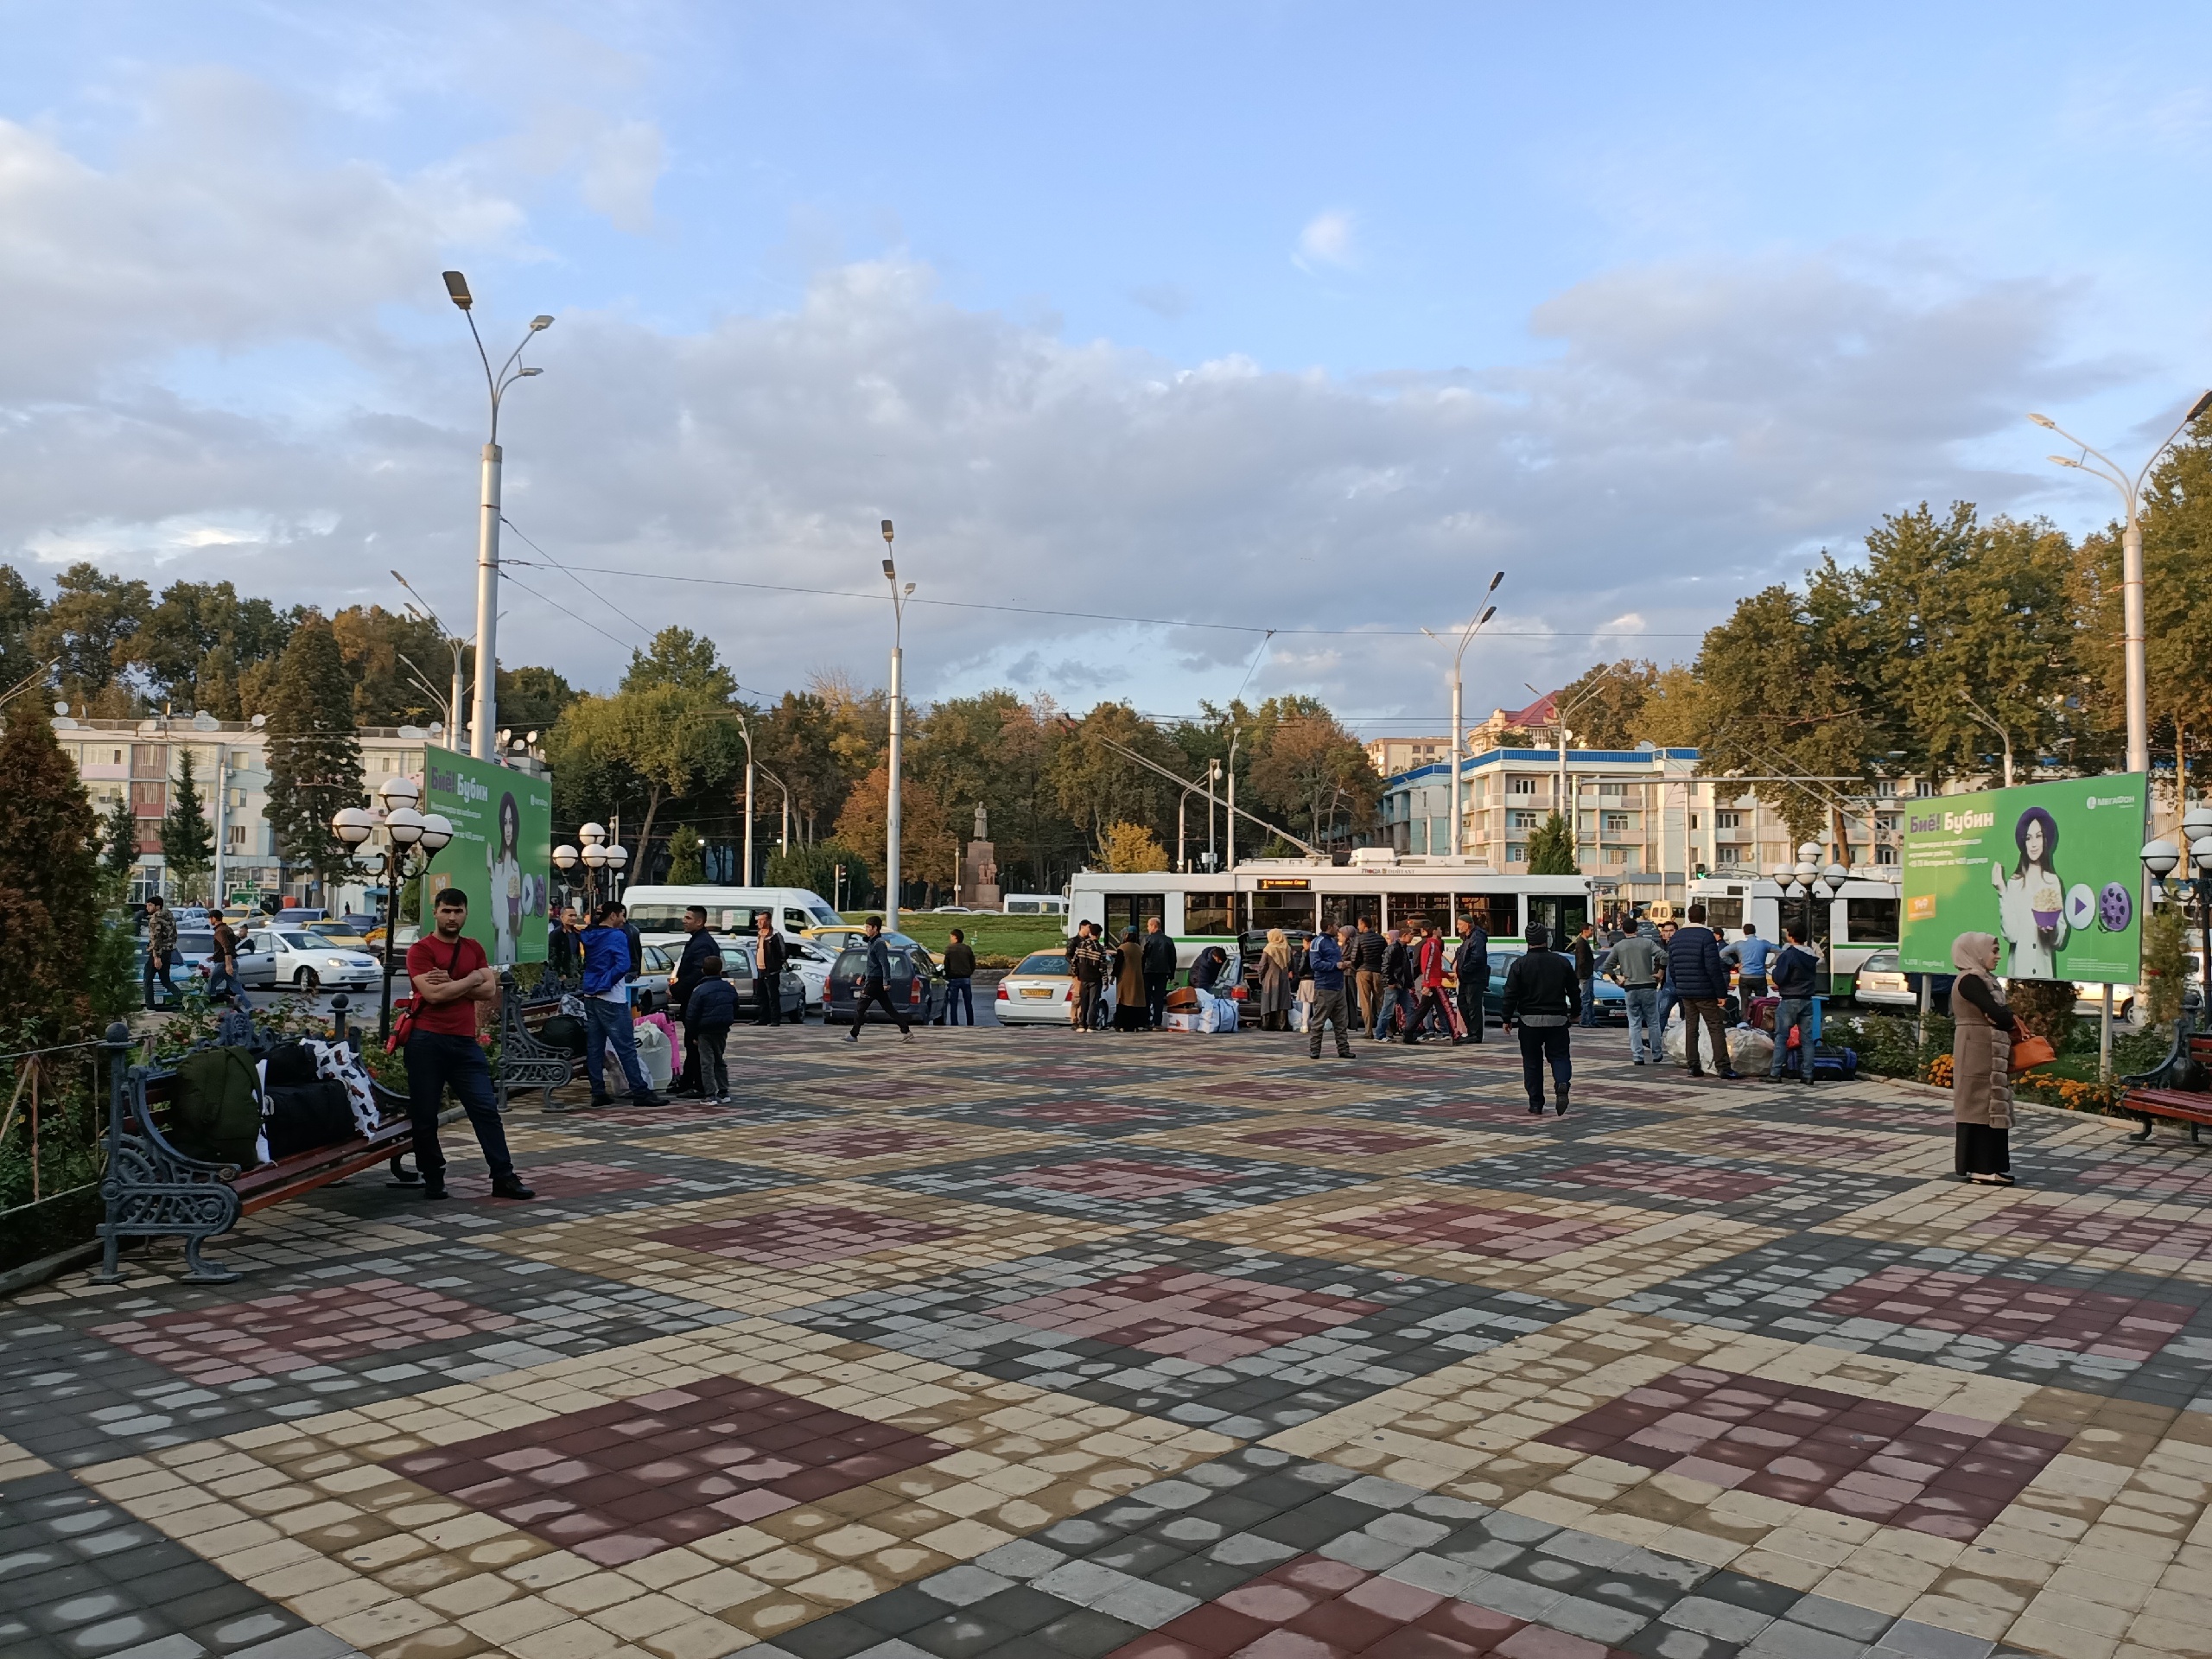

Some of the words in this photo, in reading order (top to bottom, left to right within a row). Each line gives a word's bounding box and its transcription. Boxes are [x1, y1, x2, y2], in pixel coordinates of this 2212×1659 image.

[431, 766, 454, 793] Биё!
[457, 773, 488, 803] Бубин
[1910, 813, 1941, 833] Биё!
[1944, 810, 1994, 834] Бубин
